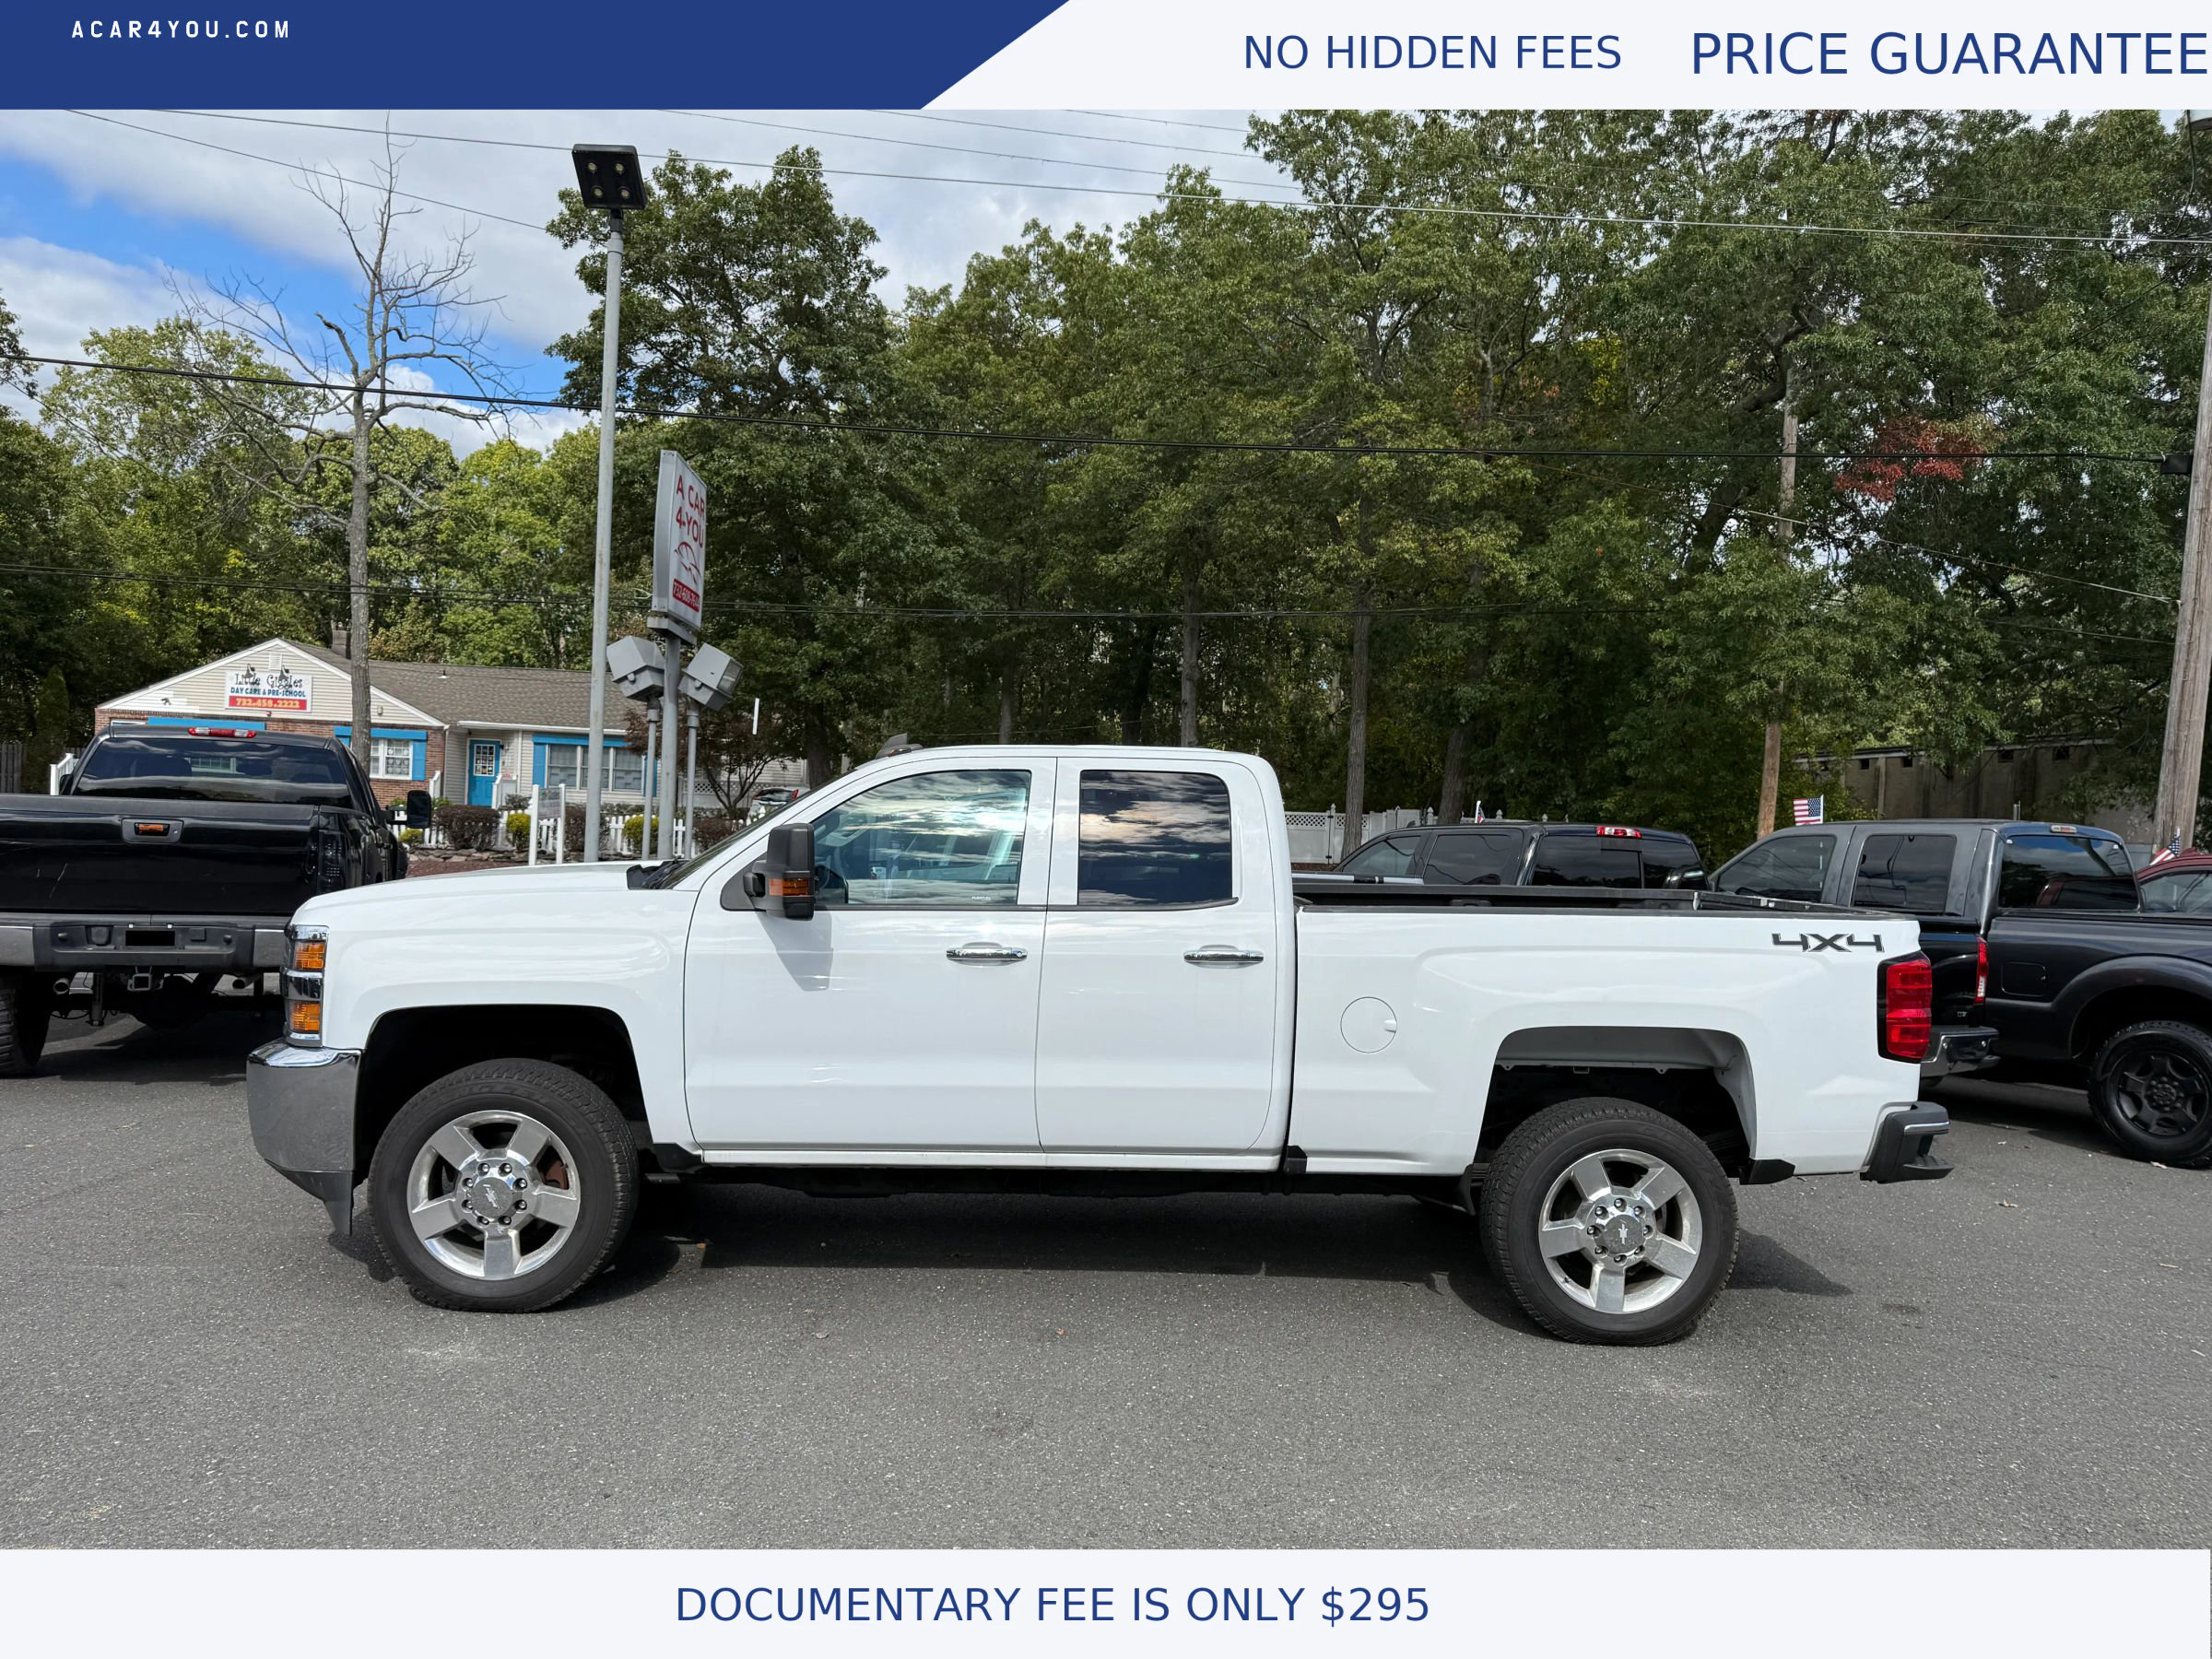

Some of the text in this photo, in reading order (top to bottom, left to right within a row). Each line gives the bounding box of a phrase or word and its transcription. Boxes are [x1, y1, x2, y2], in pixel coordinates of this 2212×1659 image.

[676, 474, 705, 520] A CAR
[266, 674, 303, 689] Giggles
[267, 689, 306, 698] PRE-SCHOOL
